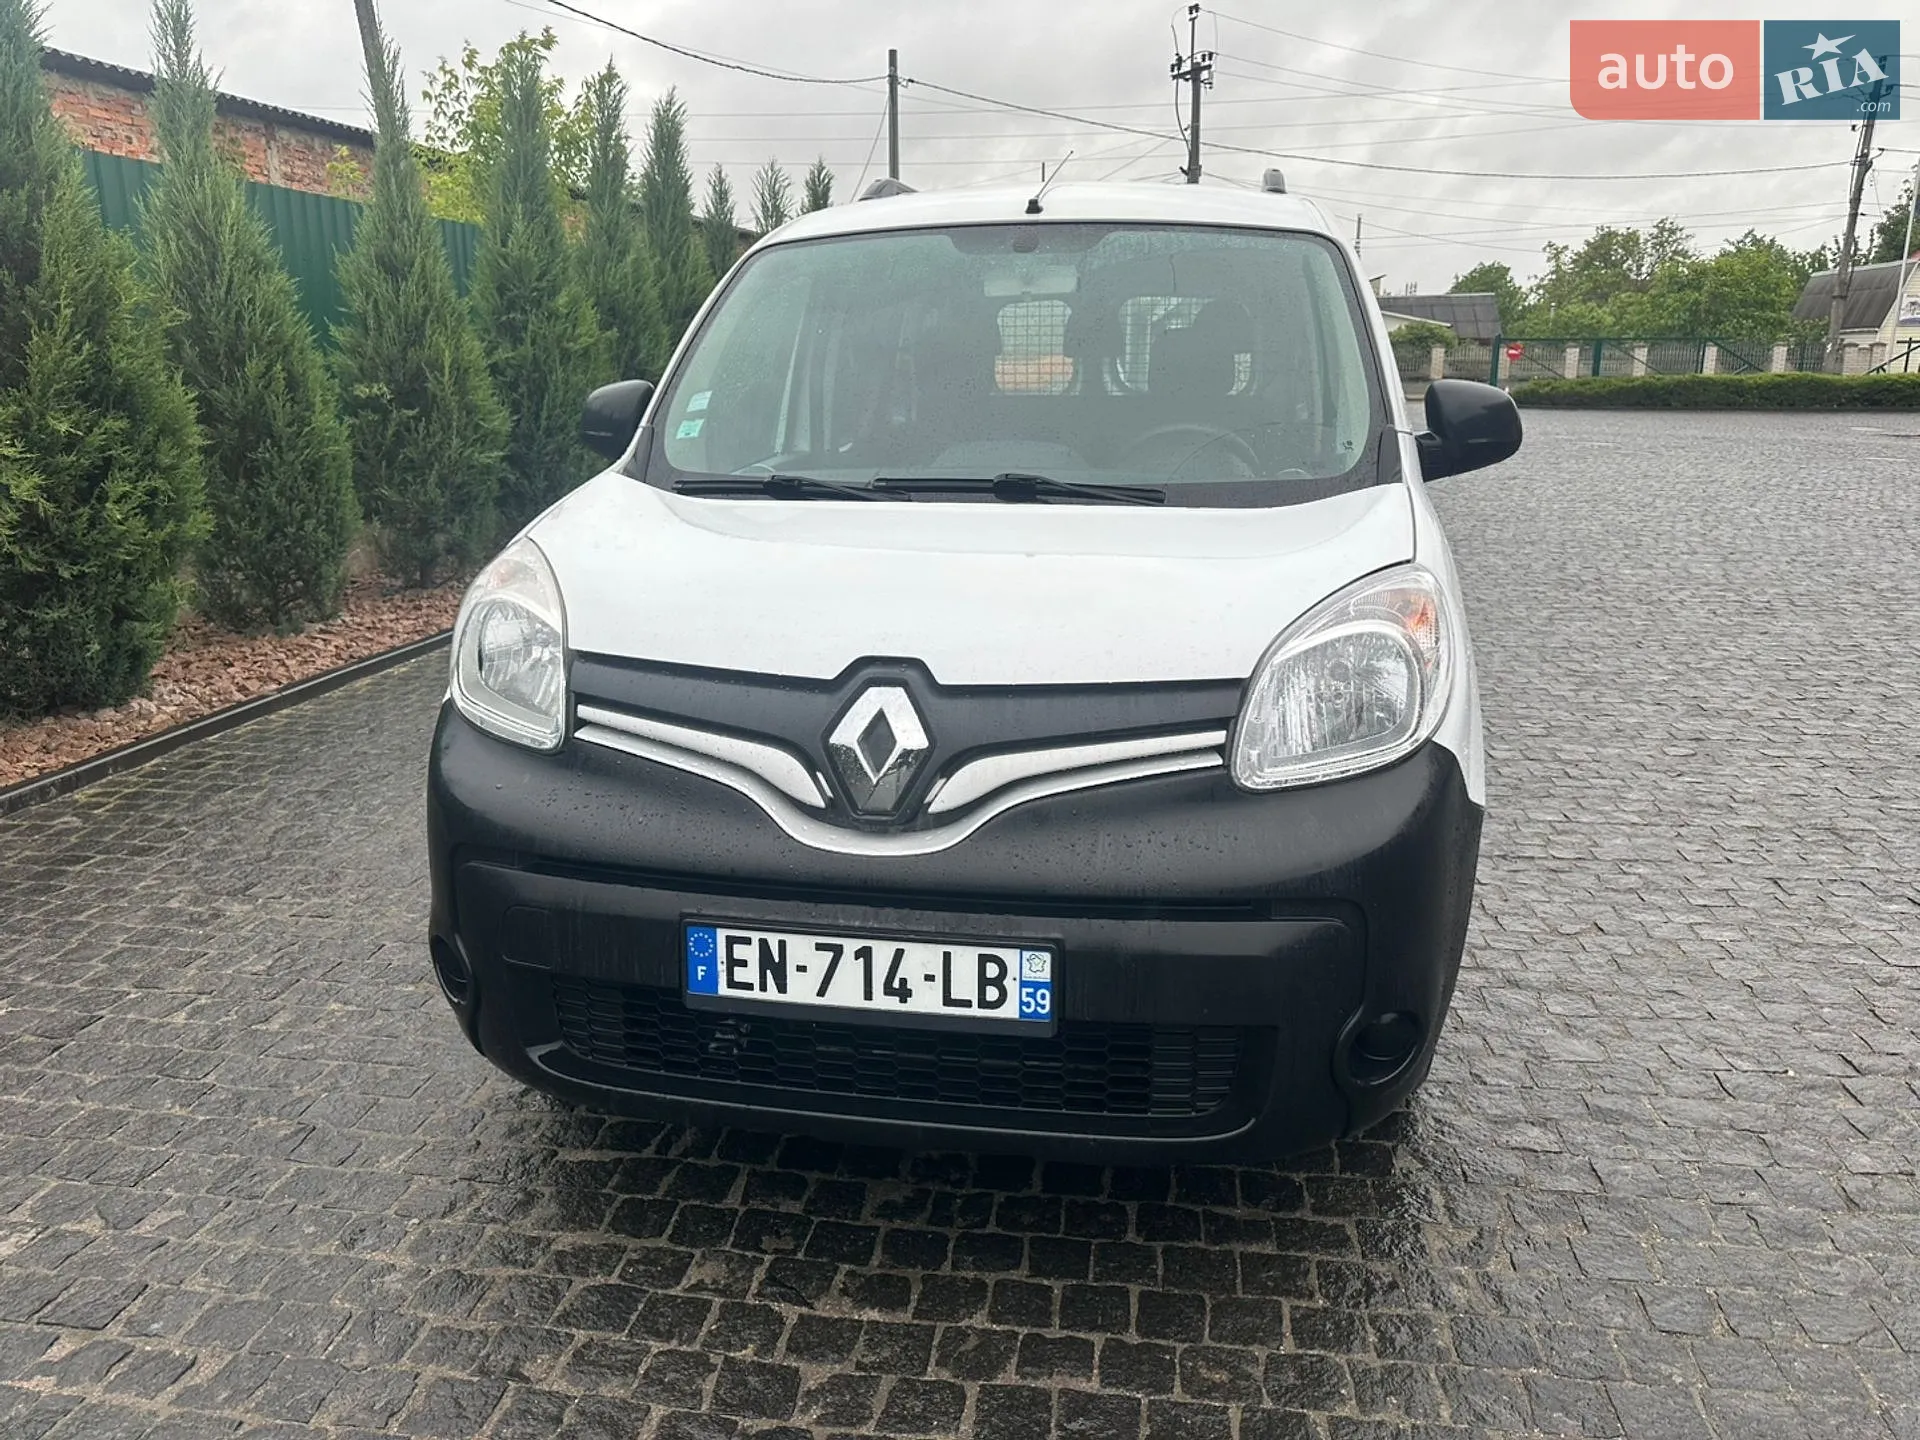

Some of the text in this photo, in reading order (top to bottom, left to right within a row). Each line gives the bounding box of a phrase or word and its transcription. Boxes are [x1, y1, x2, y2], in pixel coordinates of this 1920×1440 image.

[697, 966, 706, 981] F
[725, 935, 1008, 1010] EN-714-LB
[1021, 987, 1050, 1015] 59
